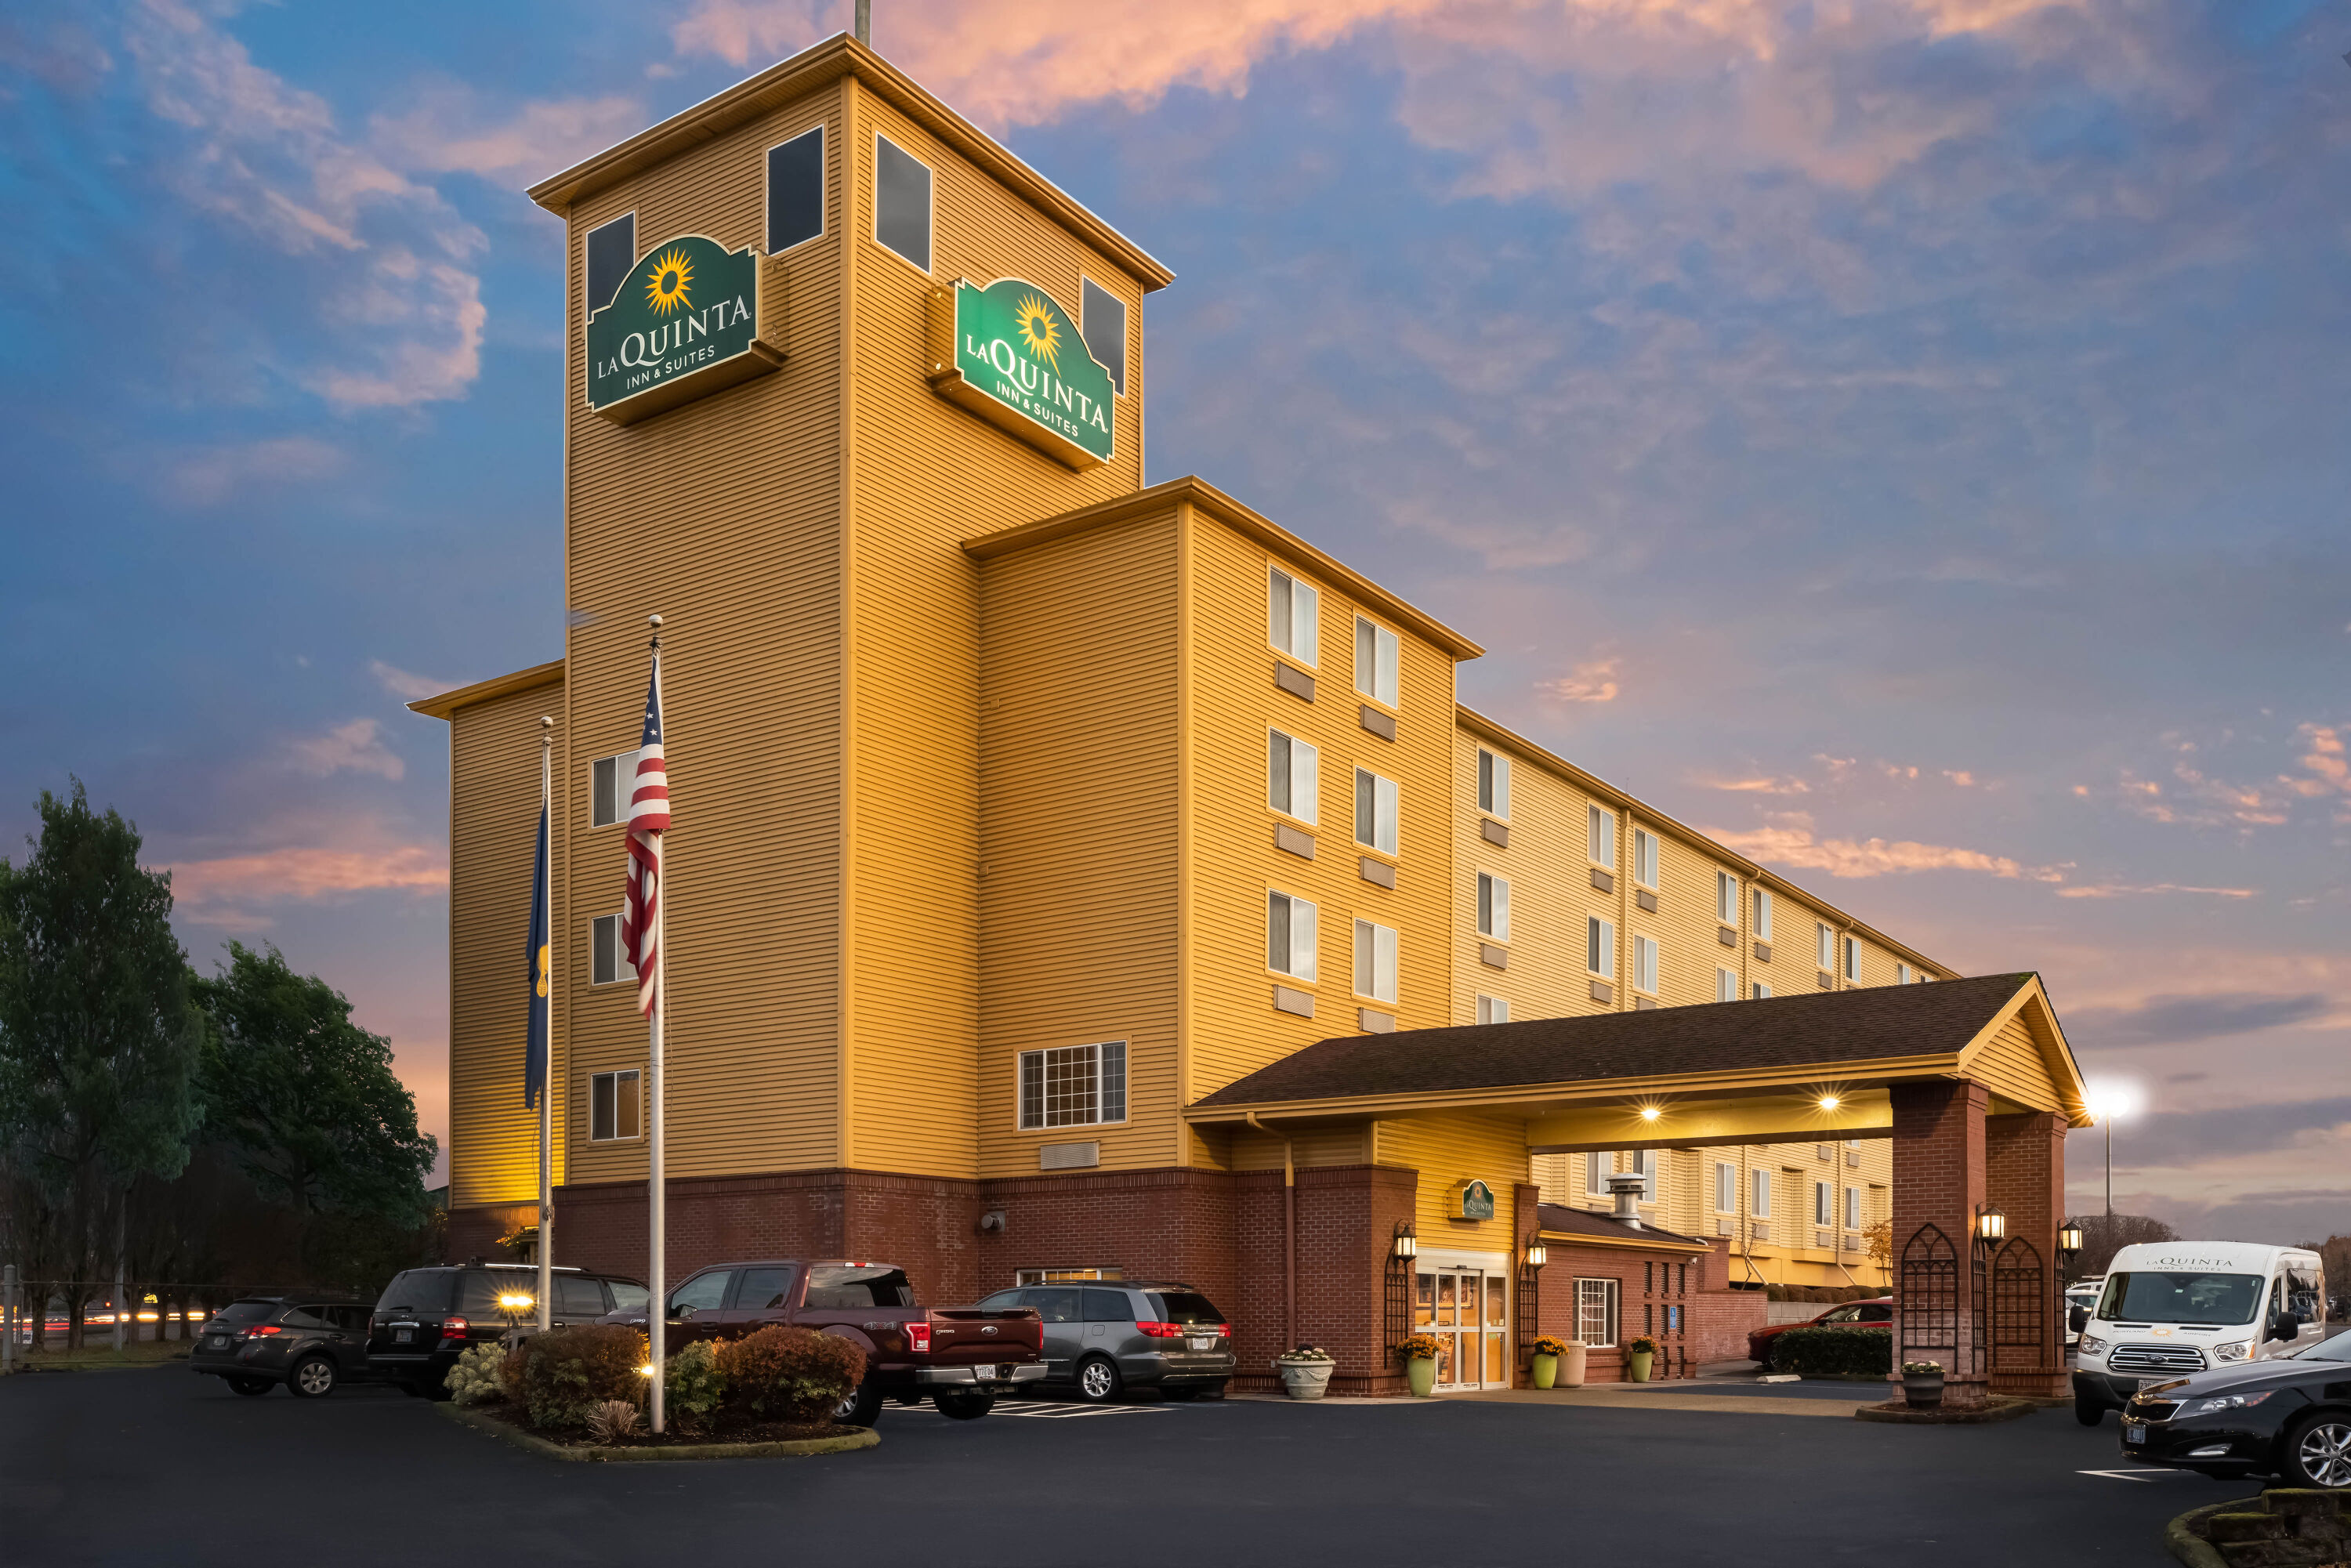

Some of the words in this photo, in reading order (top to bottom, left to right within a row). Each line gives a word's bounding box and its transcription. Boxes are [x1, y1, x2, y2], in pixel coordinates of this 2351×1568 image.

[597, 357, 619, 379] LA
[620, 295, 751, 367] QUINTA
[627, 370, 650, 389] INN
[654, 368, 661, 378] &
[665, 345, 715, 374] SUITES
[966, 334, 990, 364] LA
[990, 339, 1107, 433] QUINTA
[997, 380, 1020, 404] INN
[1023, 398, 1031, 410] &
[1034, 404, 1078, 437] SUITES
[1469, 1200, 1492, 1211] QUINTA
[2160, 1257, 2232, 1266] QUINTA
